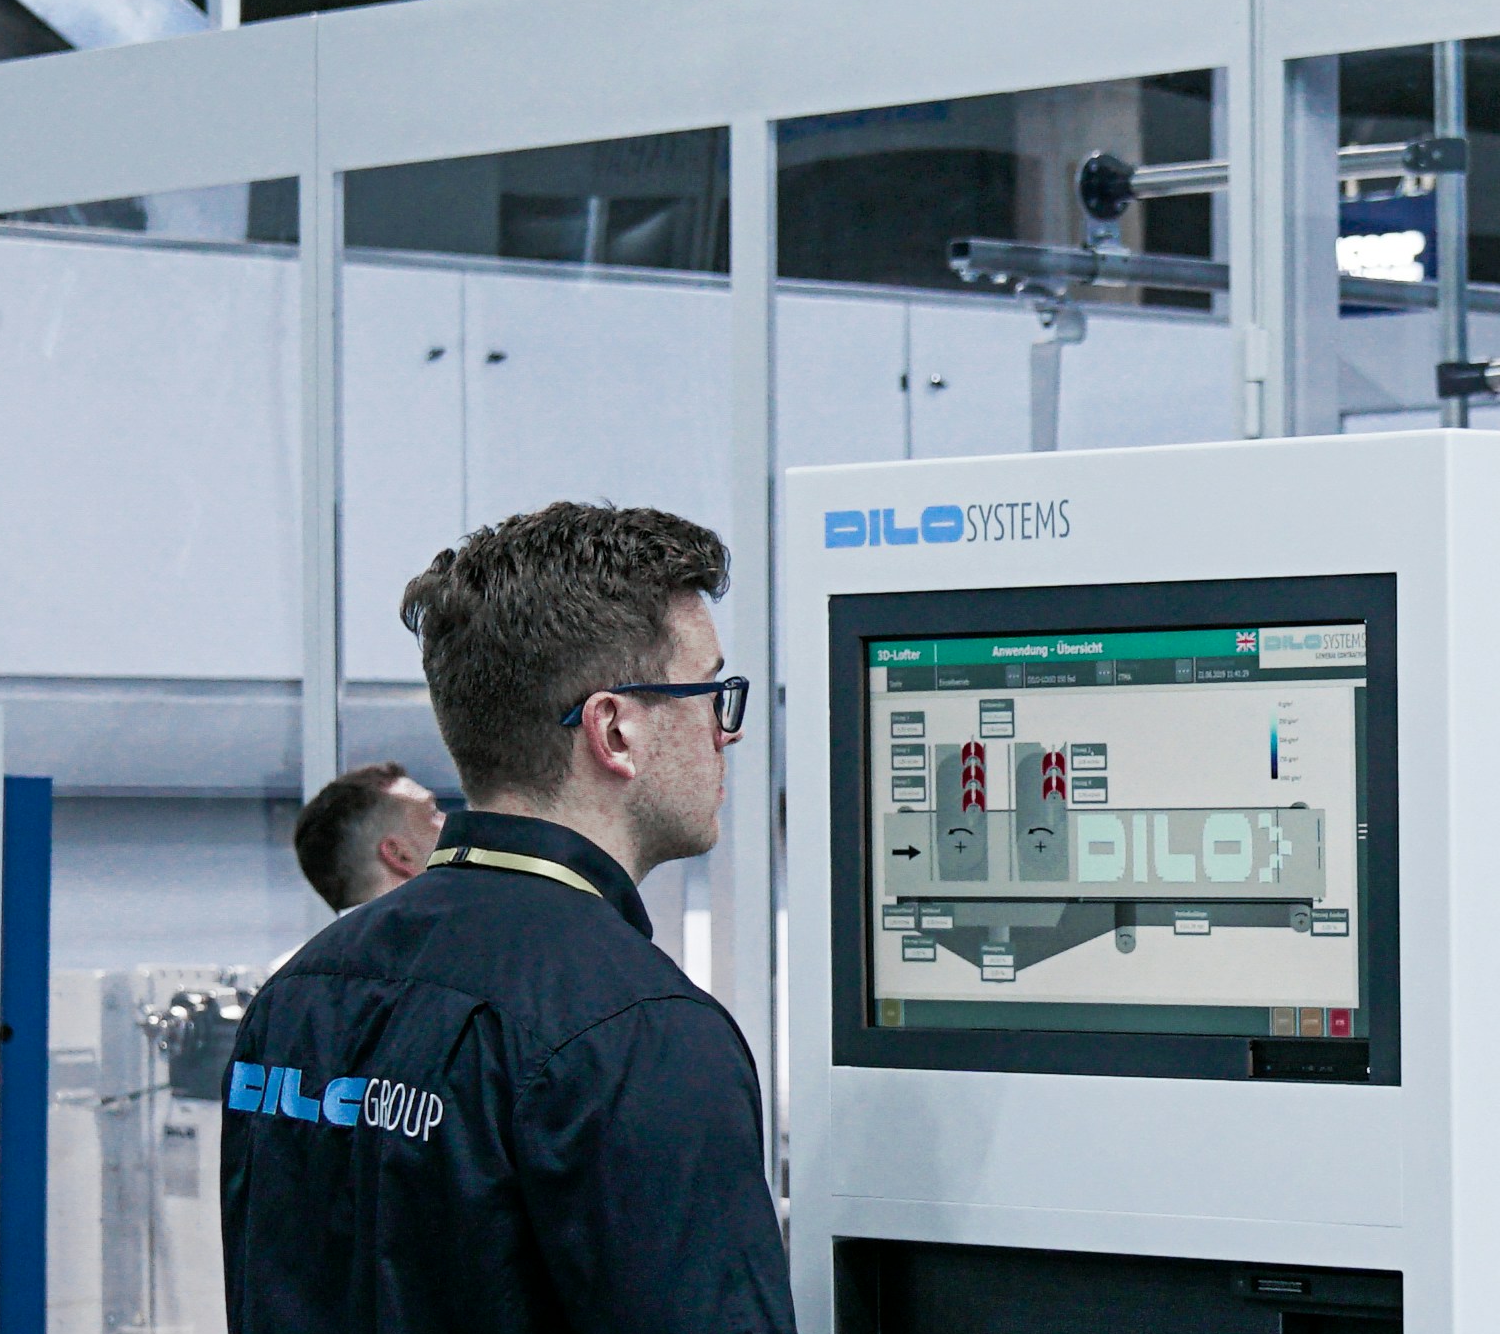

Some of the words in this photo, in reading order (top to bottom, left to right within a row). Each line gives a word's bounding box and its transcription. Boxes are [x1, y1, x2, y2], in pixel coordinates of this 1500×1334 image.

[824, 505, 964, 549] DILO
[966, 499, 1070, 542] SYSTEMS
[877, 649, 921, 661] 3D-Lofter
[992, 645, 1048, 658] Anwendung
[1056, 641, 1103, 655] Übersicht
[1264, 634, 1322, 651] DILO
[1078, 813, 1253, 883] DILO
[364, 1077, 444, 1142] GROUP
